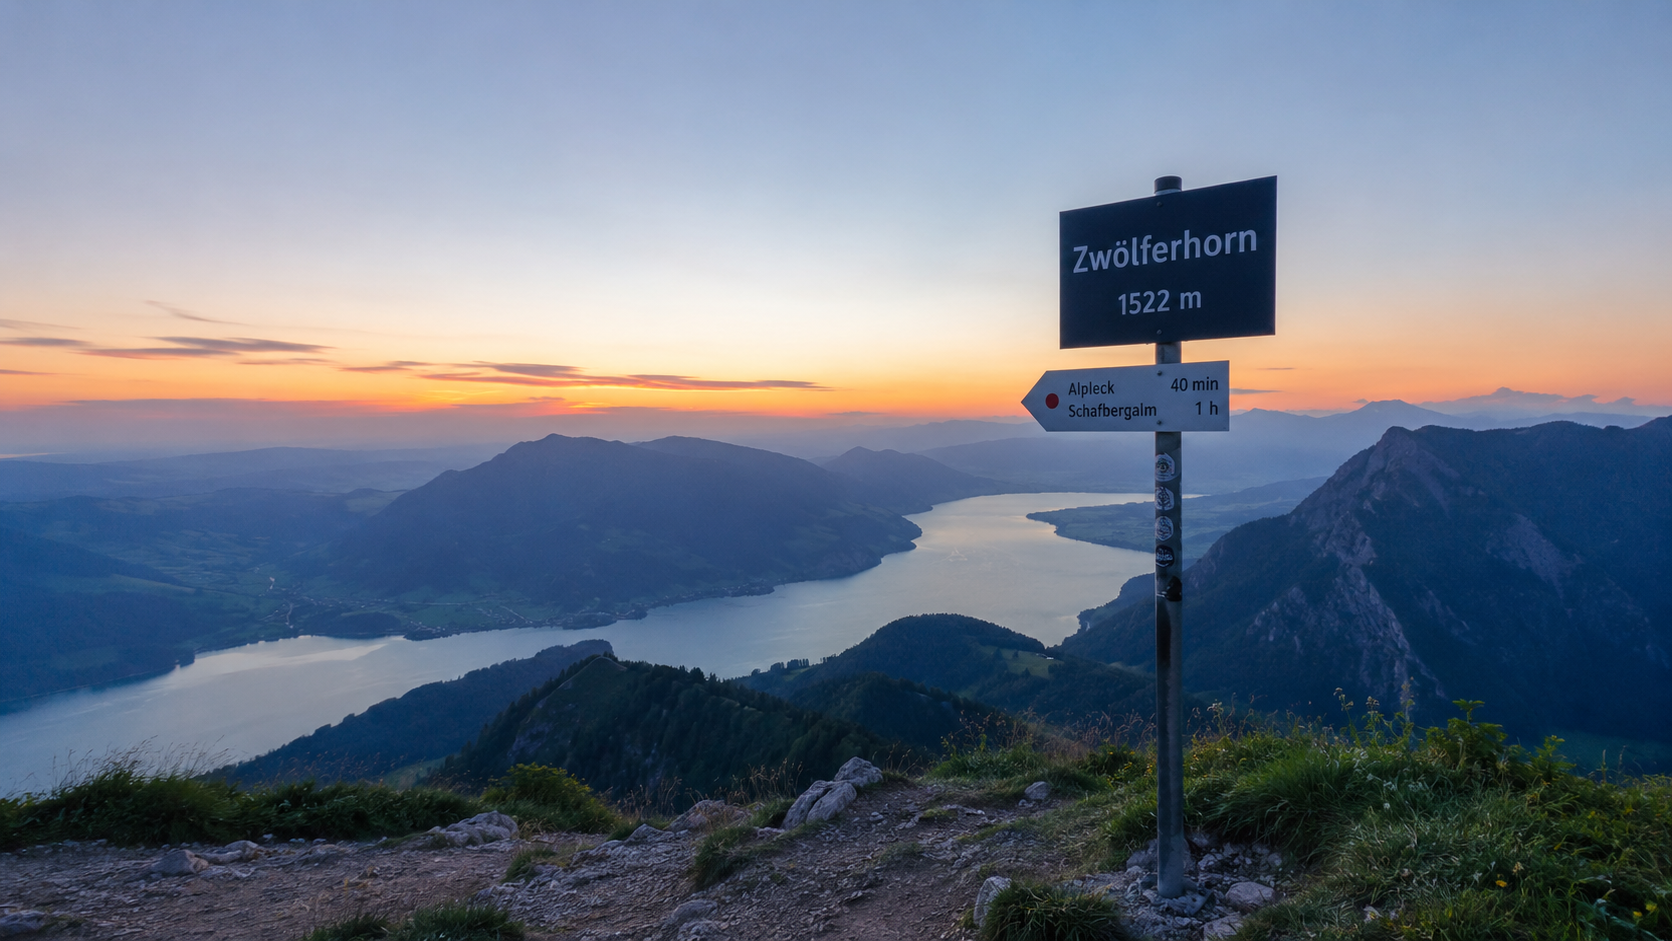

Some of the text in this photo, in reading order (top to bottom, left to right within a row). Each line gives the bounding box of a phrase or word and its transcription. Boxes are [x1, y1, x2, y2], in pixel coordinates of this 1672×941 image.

[1072, 229, 1258, 274] Zwölferhorn
[1117, 289, 1202, 316] 1522 m
[1068, 376, 1219, 399] Alpleck 40 min
[1068, 400, 1219, 421] Schafbergalm 1 h
